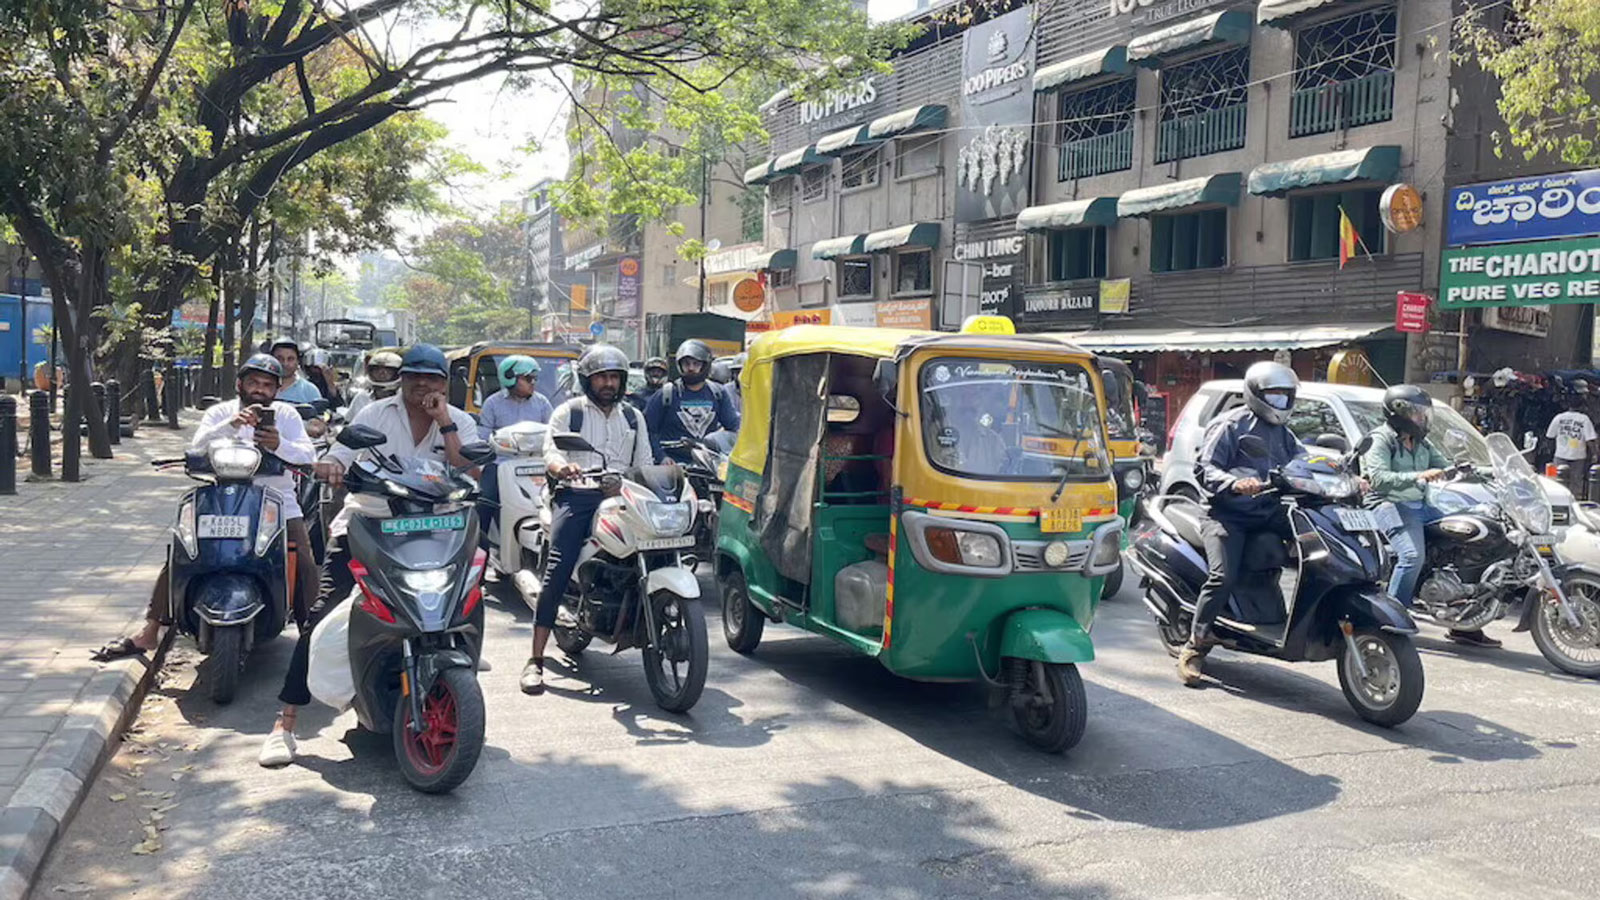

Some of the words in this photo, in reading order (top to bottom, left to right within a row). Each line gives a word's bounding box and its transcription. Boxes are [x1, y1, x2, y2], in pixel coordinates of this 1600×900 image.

[965, 73, 985, 95] 100
[985, 62, 1025, 89] PIPERS
[824, 77, 877, 117] PIPERS
[954, 241, 985, 260] CHIN
[987, 236, 1023, 256] LUNG
[1448, 256, 1485, 273] THE
[1485, 248, 1600, 278] CHARIOT
[1061, 296, 1093, 310] BAZAAR
[1447, 284, 1507, 302] PURE
[1512, 281, 1561, 299] VEG
